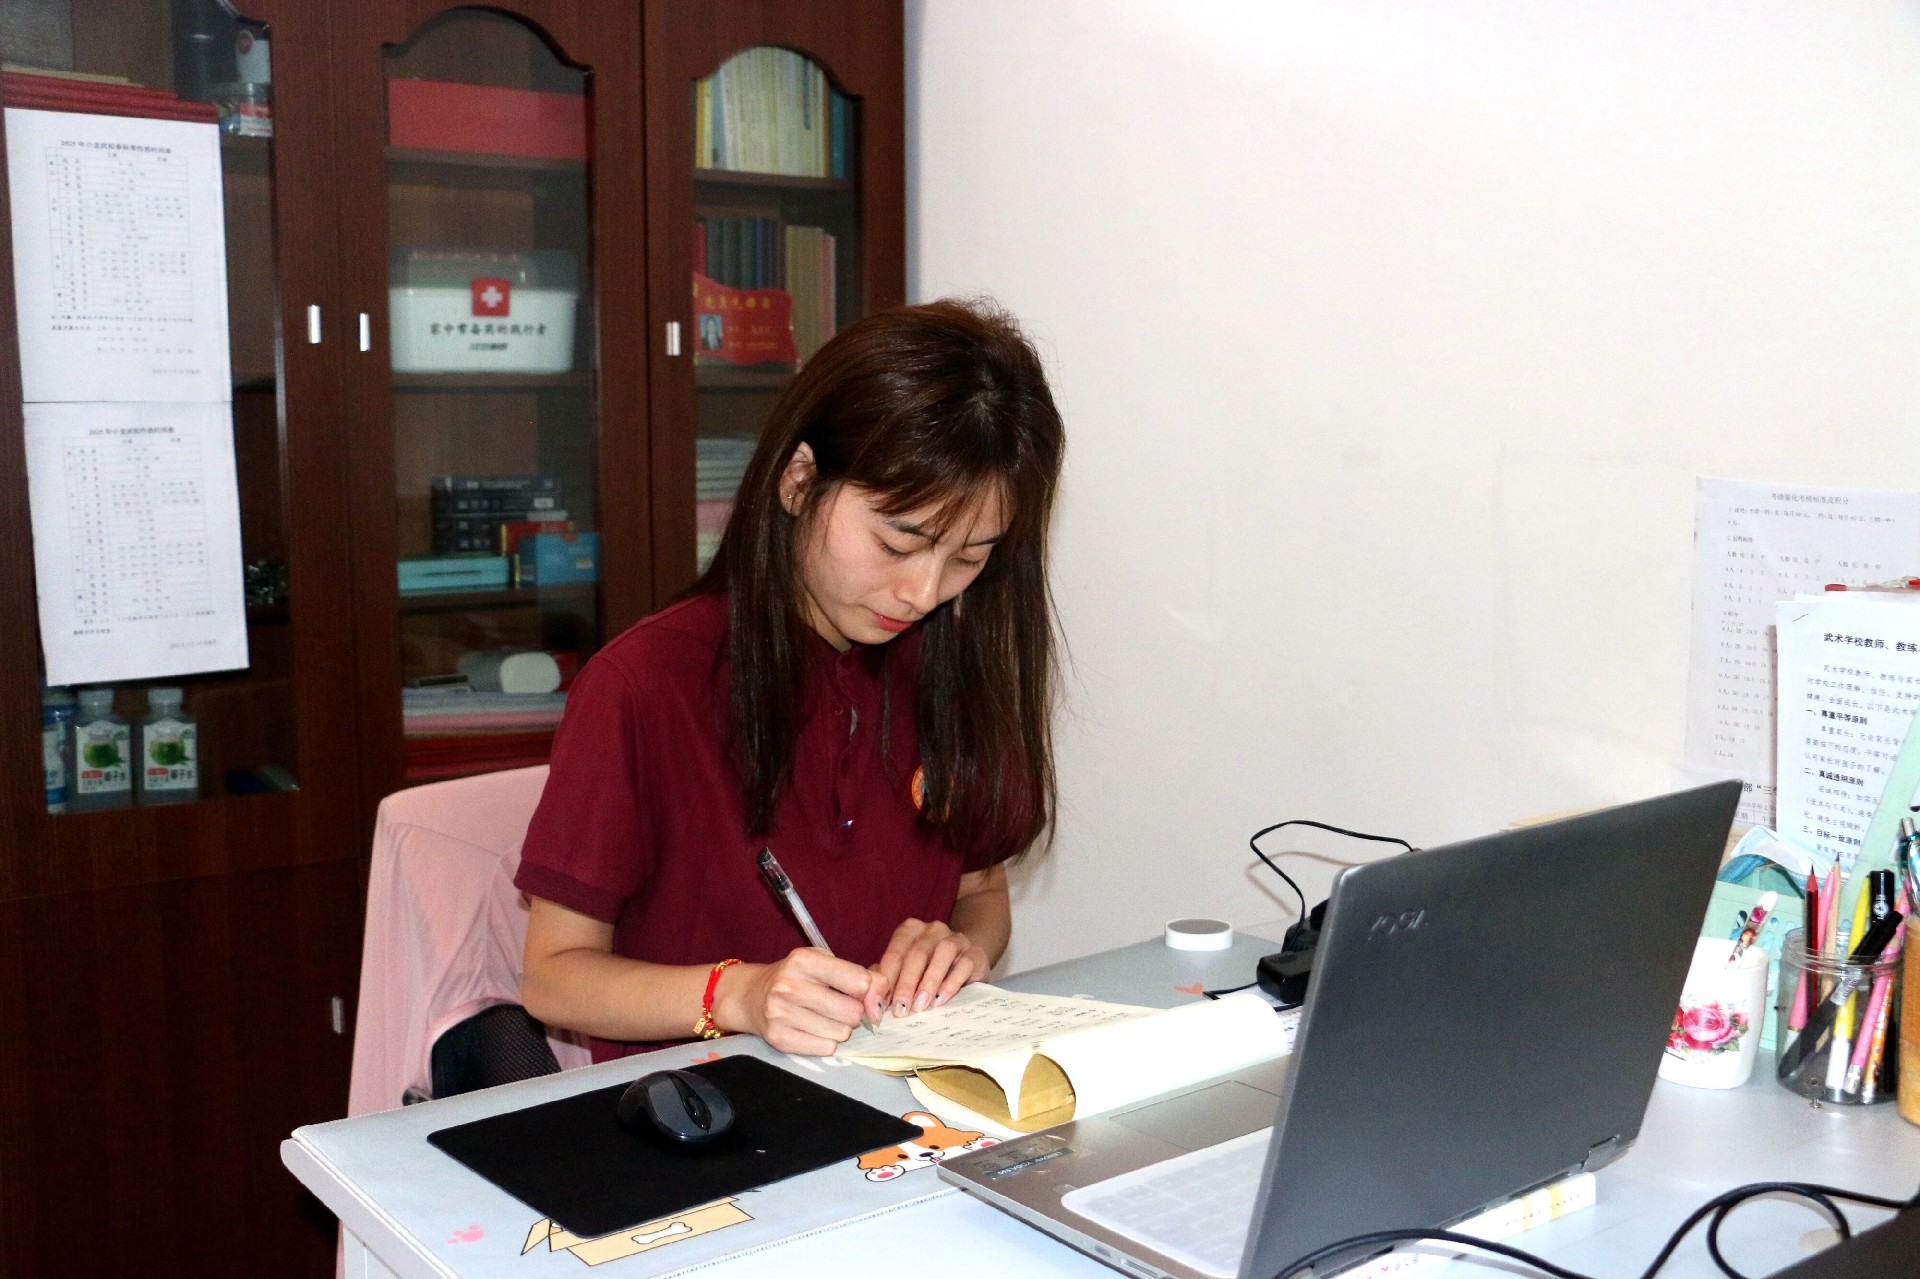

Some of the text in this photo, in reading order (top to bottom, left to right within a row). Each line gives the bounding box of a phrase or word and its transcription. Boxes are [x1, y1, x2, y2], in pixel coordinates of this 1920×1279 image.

[1823, 632, 1920, 653] 武术学校教师、教练
[1806, 709, 1868, 726] 一、尊重平等原则
[1803, 767, 1864, 787] 二、真诚透明原则
[1802, 825, 1861, 847] 三、目标一致原则
